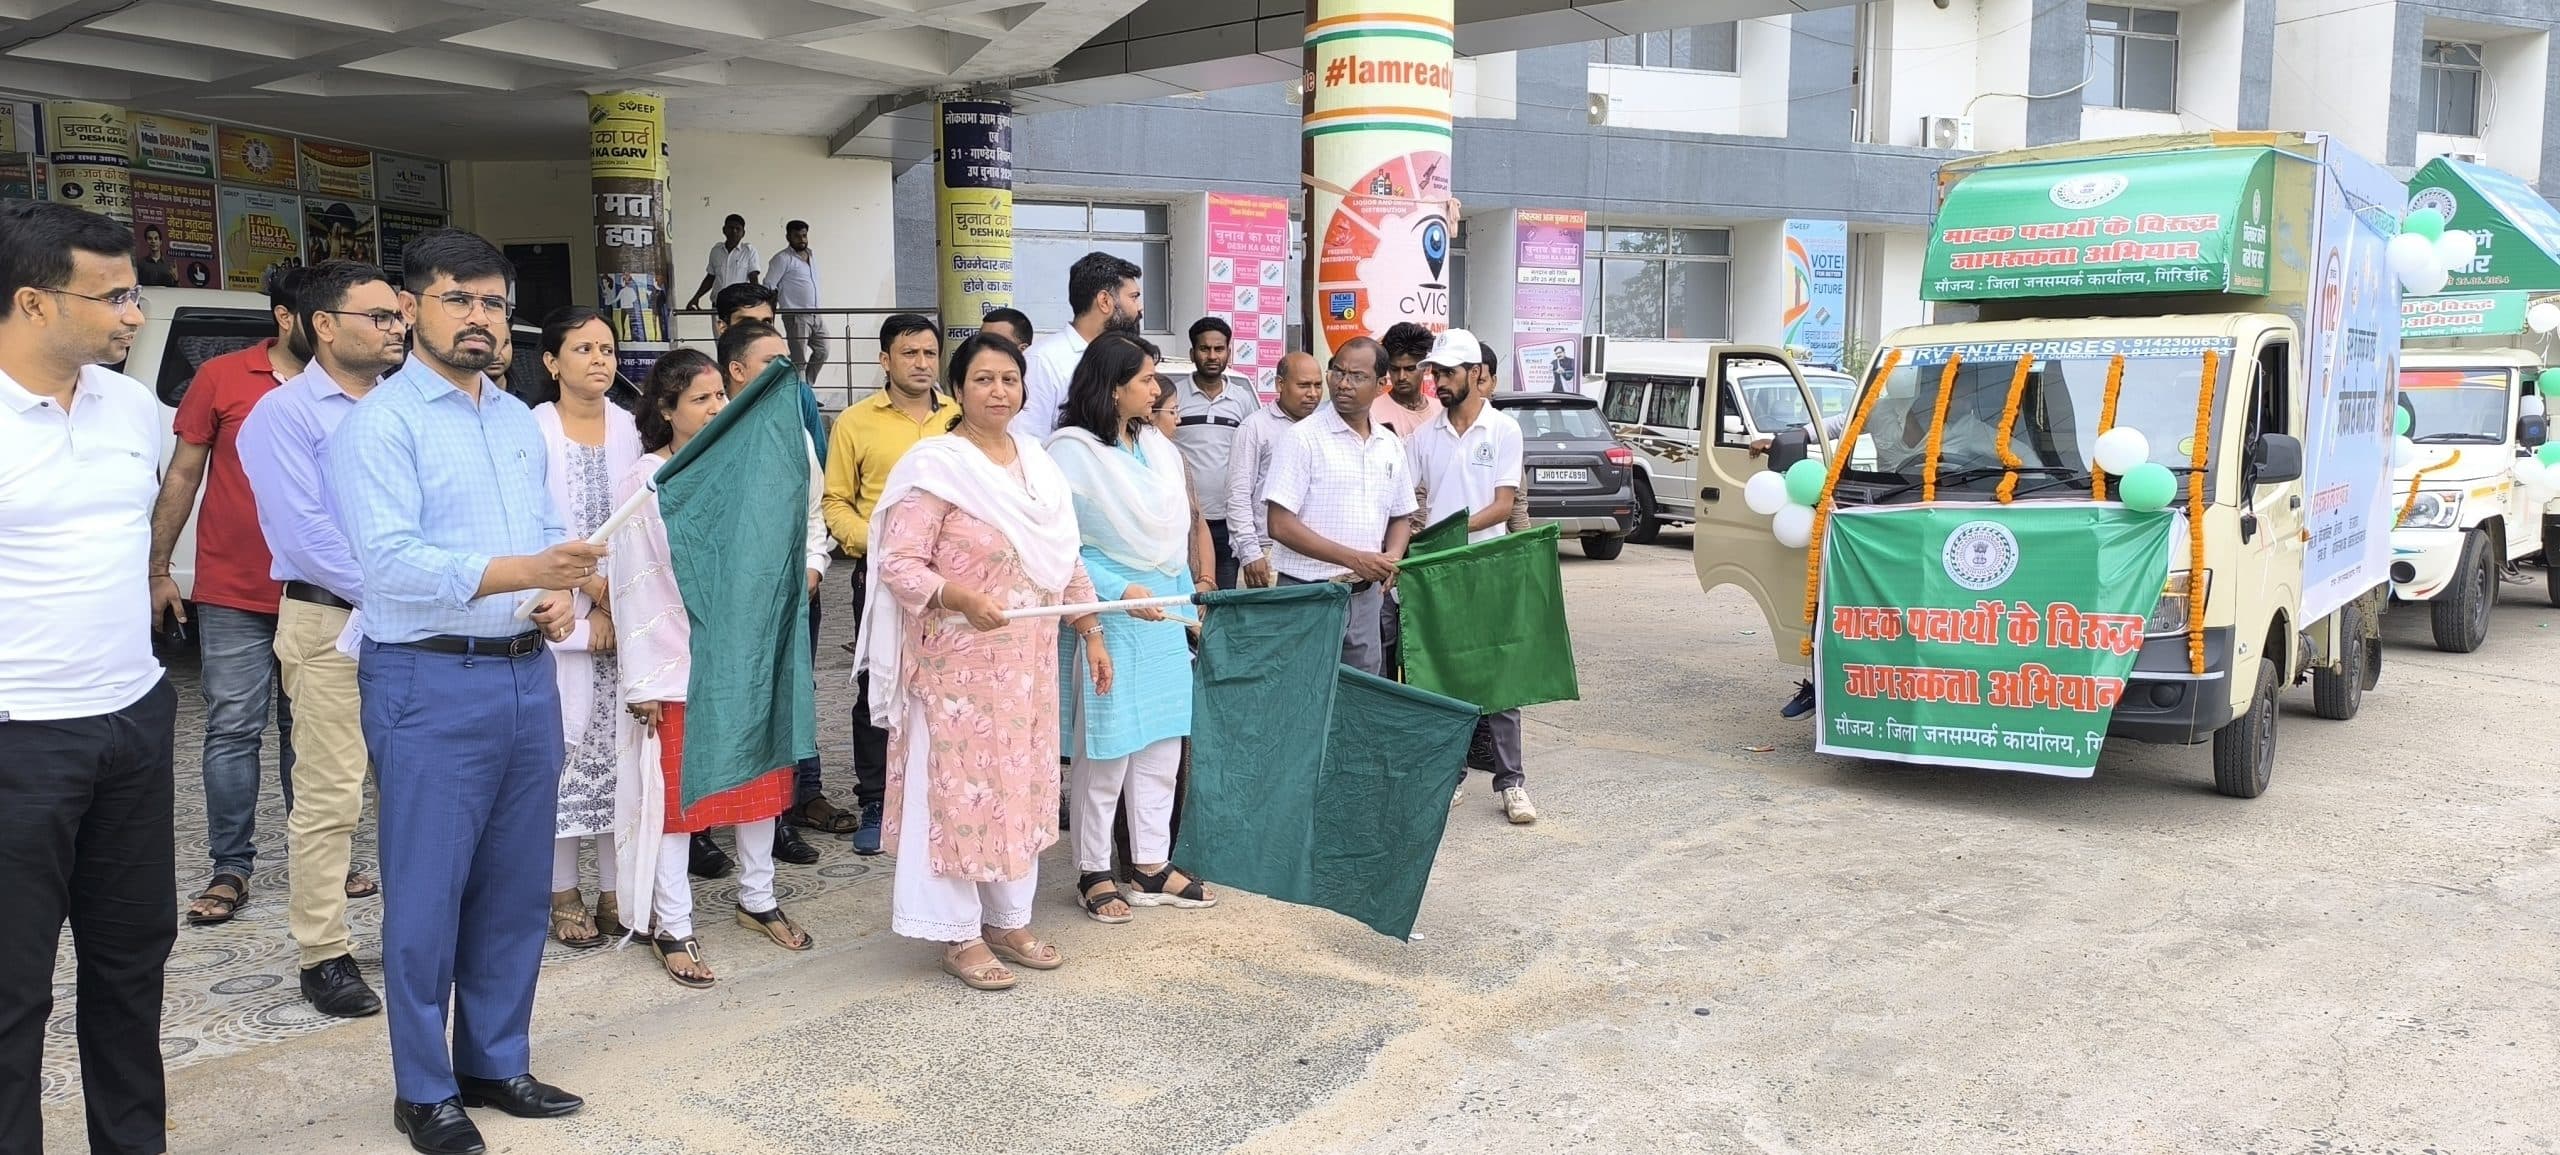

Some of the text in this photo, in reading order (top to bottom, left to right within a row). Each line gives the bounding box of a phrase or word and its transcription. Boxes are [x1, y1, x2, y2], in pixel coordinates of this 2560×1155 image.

[618, 101, 655, 113] SWEEP
[945, 110, 995, 125] लोकसभा आम
[62, 124, 122, 137] चुनाव का
[595, 127, 650, 146] का पर्व
[80, 135, 105, 143] DESH
[159, 133, 192, 149] BHARAT
[596, 147, 648, 158] KA GARV
[970, 146, 996, 161] गाण्डेय
[967, 166, 979, 178] उप
[92, 180, 117, 193] मेरा
[93, 194, 118, 208] मेरा
[603, 193, 653, 218] मत
[256, 216, 271, 226] AM
[955, 213, 1007, 230] चुनाव का
[251, 225, 288, 238] INDIA
[604, 224, 654, 248] हक
[970, 228, 1005, 237] DESH KA
[1214, 230, 1282, 245] चुनाव का पर्व
[1943, 225, 2015, 245] मादक
[2018, 217, 2101, 241] पदार्थों
[2103, 216, 2130, 236] के
[251, 240, 297, 251] DEMOCRACY
[2083, 240, 2202, 265] अभियान
[953, 255, 998, 270] जिम्मेदार
[1811, 254, 1845, 269] VOTE!
[963, 277, 1000, 293] होने का
[1934, 275, 1974, 293] सौजन्य
[1986, 274, 2020, 292] जिला
[2022, 269, 2086, 289] जनसम्पर्क
[2155, 266, 2210, 284] गिरिडीह
[1814, 283, 1843, 294] FUTURE
[1916, 340, 2116, 360] RV ENTERPRISES
[1833, 605, 1903, 642] मादक
[1906, 600, 2006, 646] पदार्थों
[2007, 601, 2041, 648] के
[1987, 663, 2126, 712] अभियान
[1834, 712, 1874, 737] सौजन्य
[1886, 717, 1917, 744] जिला
[1921, 722, 1998, 750] जनसम्पर्क
[2001, 727, 2082, 757] कार्यालय,
[2086, 731, 2105, 751] गि
